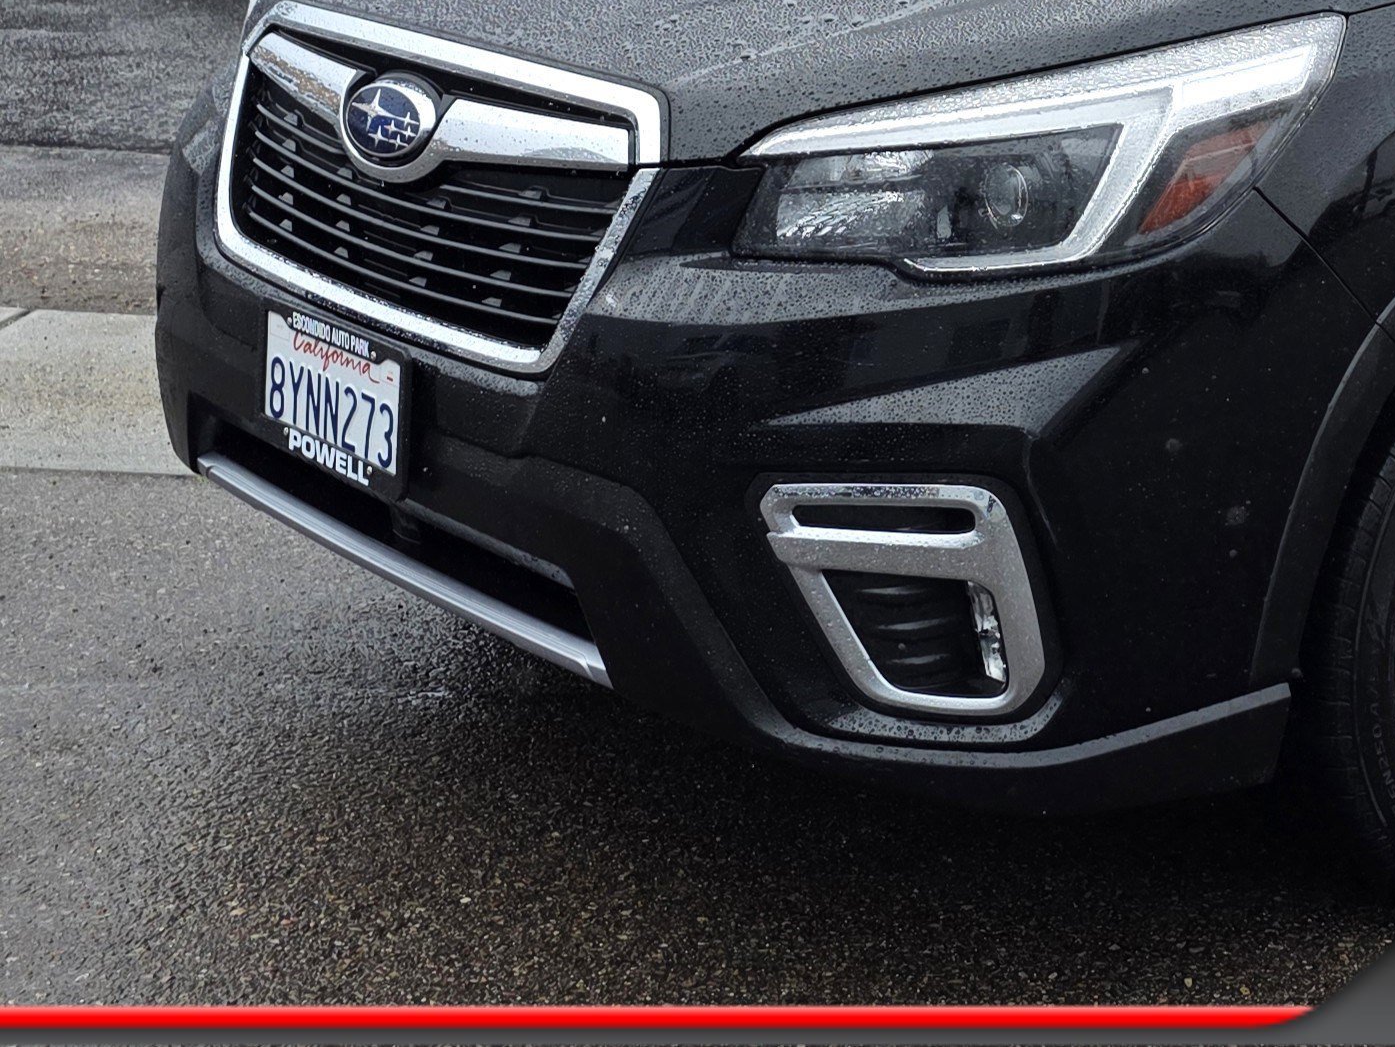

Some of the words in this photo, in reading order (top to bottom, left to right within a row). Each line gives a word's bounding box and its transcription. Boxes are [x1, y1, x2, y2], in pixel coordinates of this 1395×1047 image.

[331, 327, 350, 350] AUTO
[350, 335, 370, 358] PARK
[269, 356, 394, 469] 8YNN273
[288, 427, 369, 487] POWELL
